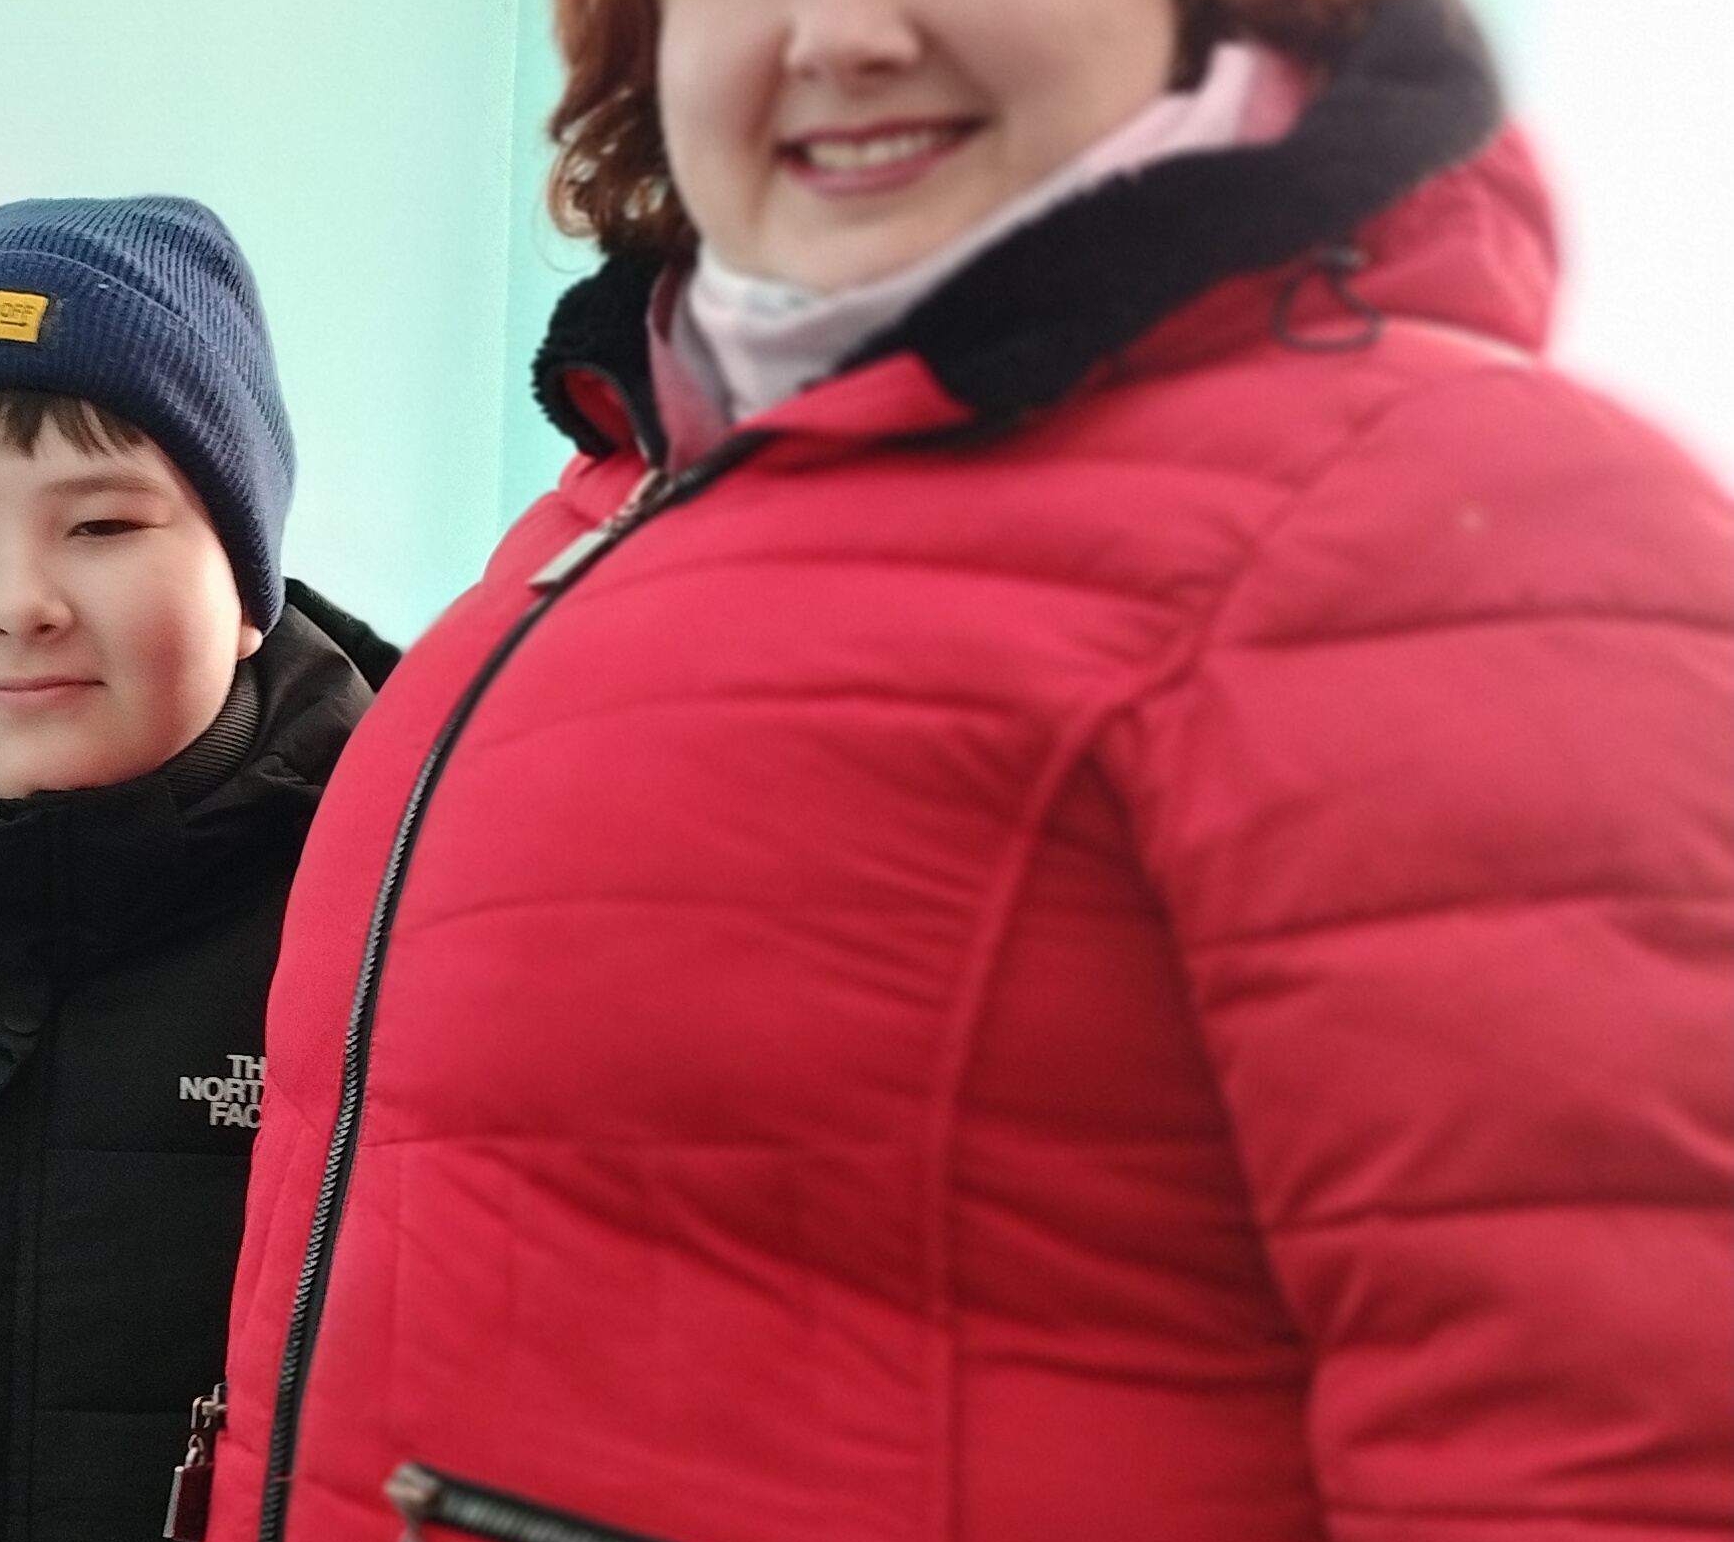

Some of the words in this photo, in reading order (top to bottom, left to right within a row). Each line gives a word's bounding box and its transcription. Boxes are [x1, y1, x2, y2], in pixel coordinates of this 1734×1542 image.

[226, 1054, 266, 1079] TH
[179, 1076, 265, 1103] NORT
[209, 1101, 262, 1129] FAC
